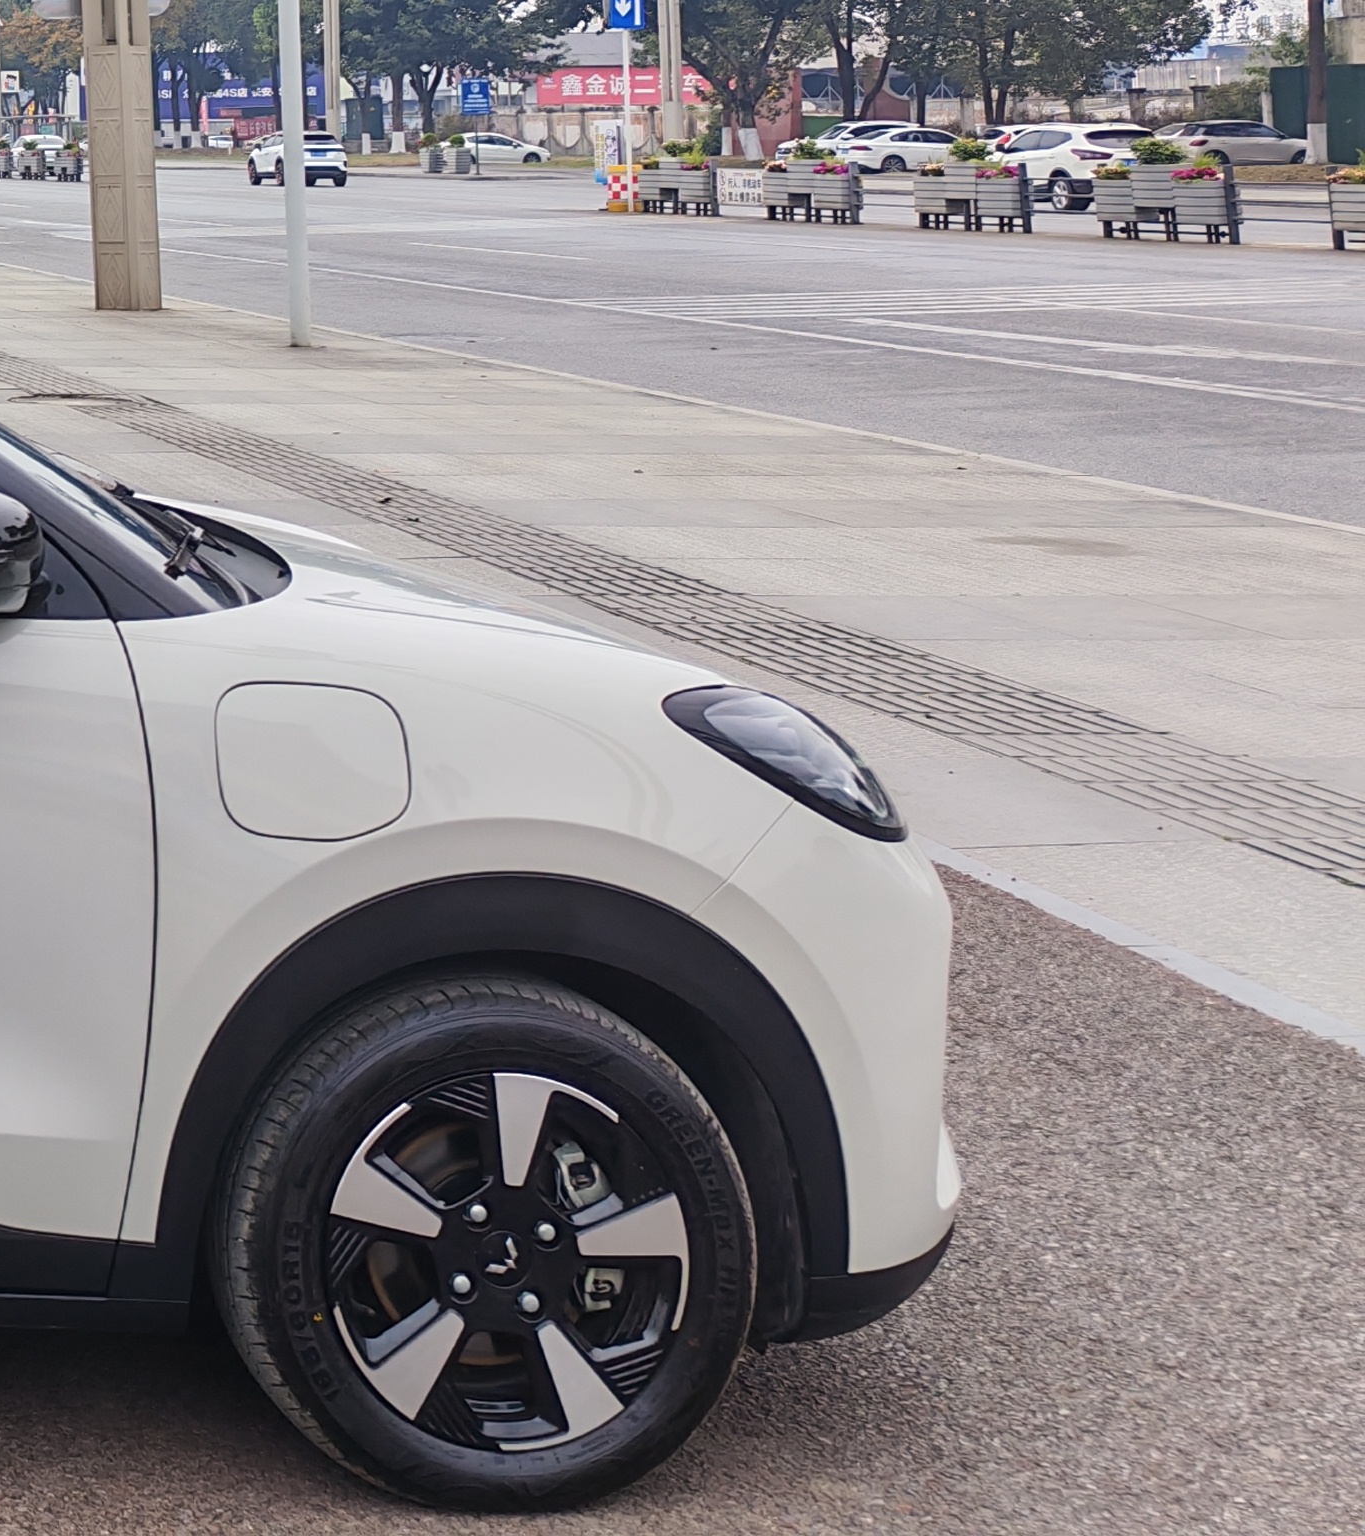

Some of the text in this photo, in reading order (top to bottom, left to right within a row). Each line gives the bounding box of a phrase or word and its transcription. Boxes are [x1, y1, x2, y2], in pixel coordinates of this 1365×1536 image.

[561, 73, 704, 97] 鑫金诚二车
